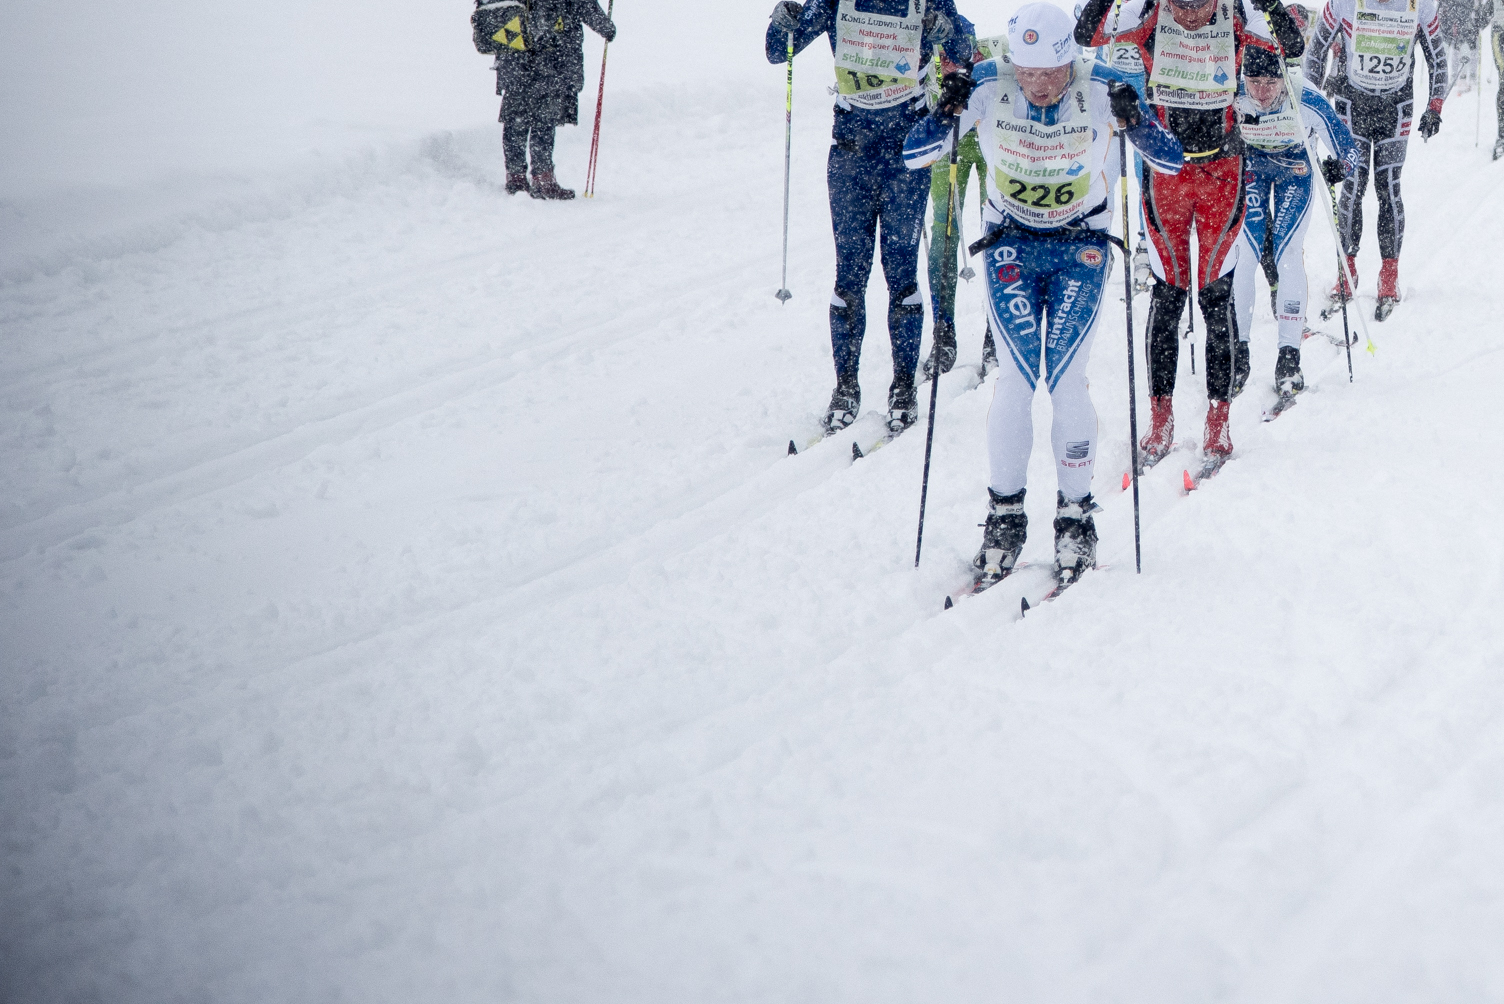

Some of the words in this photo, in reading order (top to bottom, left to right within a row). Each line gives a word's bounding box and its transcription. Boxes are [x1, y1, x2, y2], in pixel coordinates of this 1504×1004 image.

[858, 28, 898, 42] Naturpark
[1209, 29, 1230, 39] LAUF
[842, 37, 891, 52] Ammergauer
[892, 44, 915, 54] Alpen
[1179, 41, 1211, 53] Naturpark
[842, 51, 894, 69] schuster
[1160, 50, 1206, 64] Ammergauer
[1208, 53, 1229, 64] Alpen
[1358, 54, 1407, 75] 1256
[1158, 65, 1212, 82] schuster
[996, 119, 1027, 134] KÖNIG
[1029, 125, 1061, 139] LUDWIG
[1062, 125, 1088, 135] LAUF
[998, 143, 1058, 163] Ammergauer
[1060, 148, 1086, 160] Alpen
[1019, 138, 1065, 152] Naturpark
[1000, 158, 1065, 177] schuster
[1008, 178, 1075, 208] 226
[1047, 199, 1085, 219] Weissbier
[1047, 279, 1082, 349] Eintracht
[1056, 283, 1092, 351] BRAUNSCHWEIG
[1060, 459, 1093, 469] SEAT
